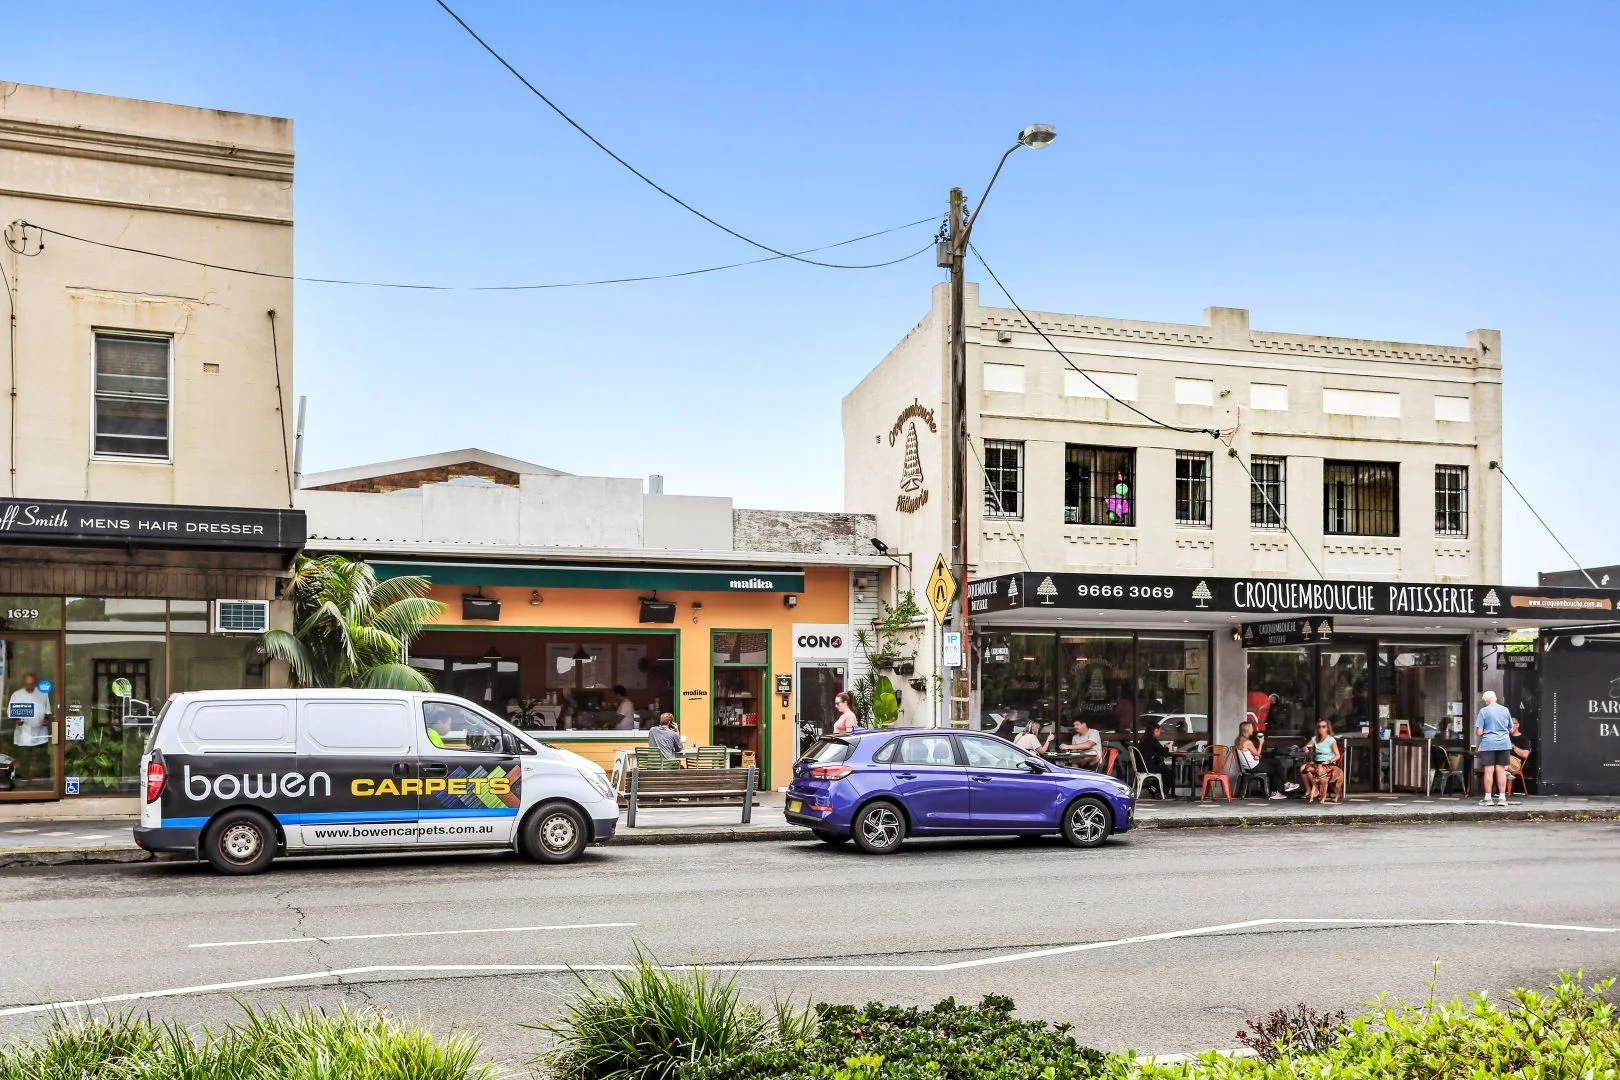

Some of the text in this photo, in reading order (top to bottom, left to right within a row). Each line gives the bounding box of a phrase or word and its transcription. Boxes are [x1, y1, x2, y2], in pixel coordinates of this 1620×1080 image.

[17, 505, 68, 528] Smith
[80, 518, 130, 529] MENS
[138, 520, 178, 531] HAIR
[186, 522, 264, 534] DRESSER
[729, 577, 773, 589] malika
[1077, 585, 1174, 598] 9666 3069
[1234, 582, 1475, 613] CROQUEMBOUCHE PATISSERIE
[1528, 599, 1603, 609] www.croquembouche.com.au
[8, 609, 39, 619] 1629
[947, 635, 958, 643] 1P
[184, 764, 511, 800] bowen CARPETS
[315, 825, 493, 839] www.bowencarpets.com.au
